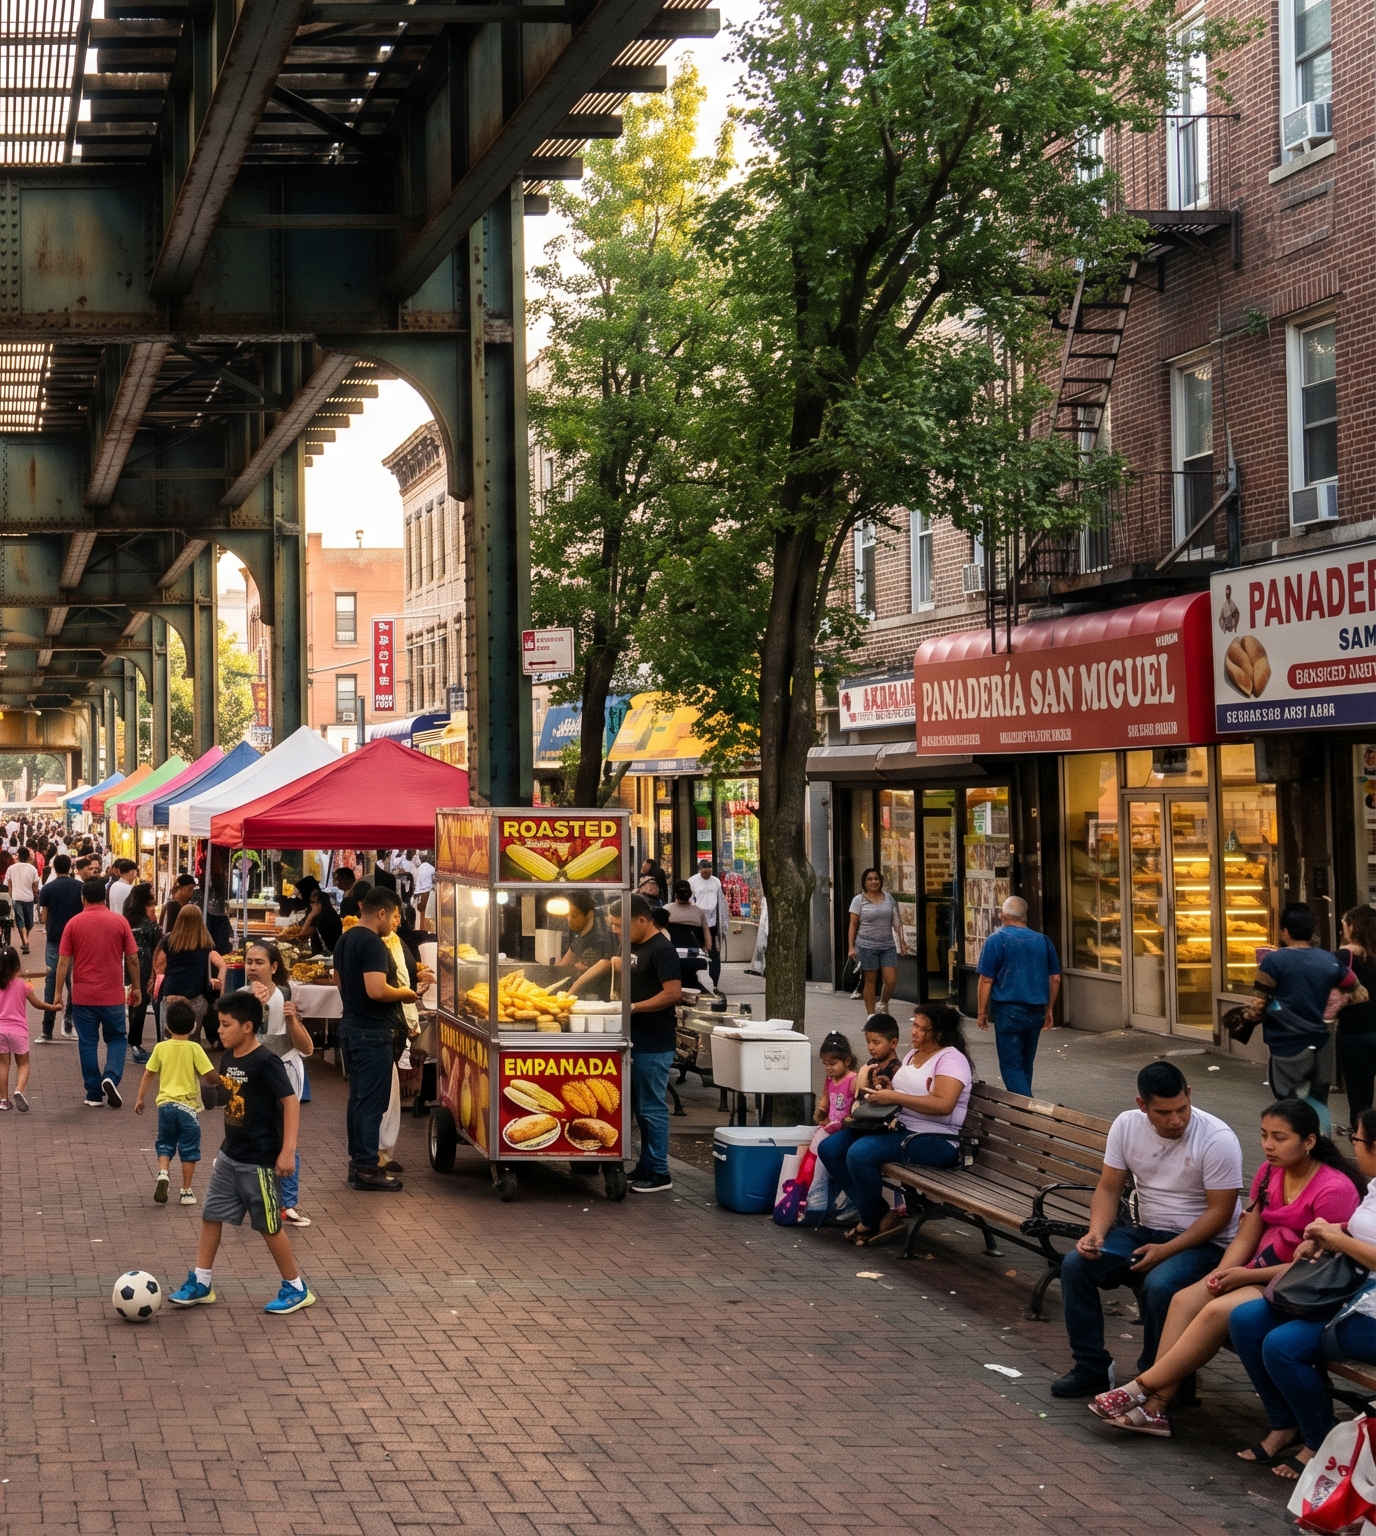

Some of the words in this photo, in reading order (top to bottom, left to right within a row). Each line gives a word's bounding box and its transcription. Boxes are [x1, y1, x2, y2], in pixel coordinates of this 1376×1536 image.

[922, 660, 1027, 722] PANADERÍA
[1030, 666, 1074, 715] SAN
[1079, 652, 1176, 712] MIGUEL
[503, 820, 617, 838] ROASTED
[504, 1057, 618, 1076] EMPANADA
